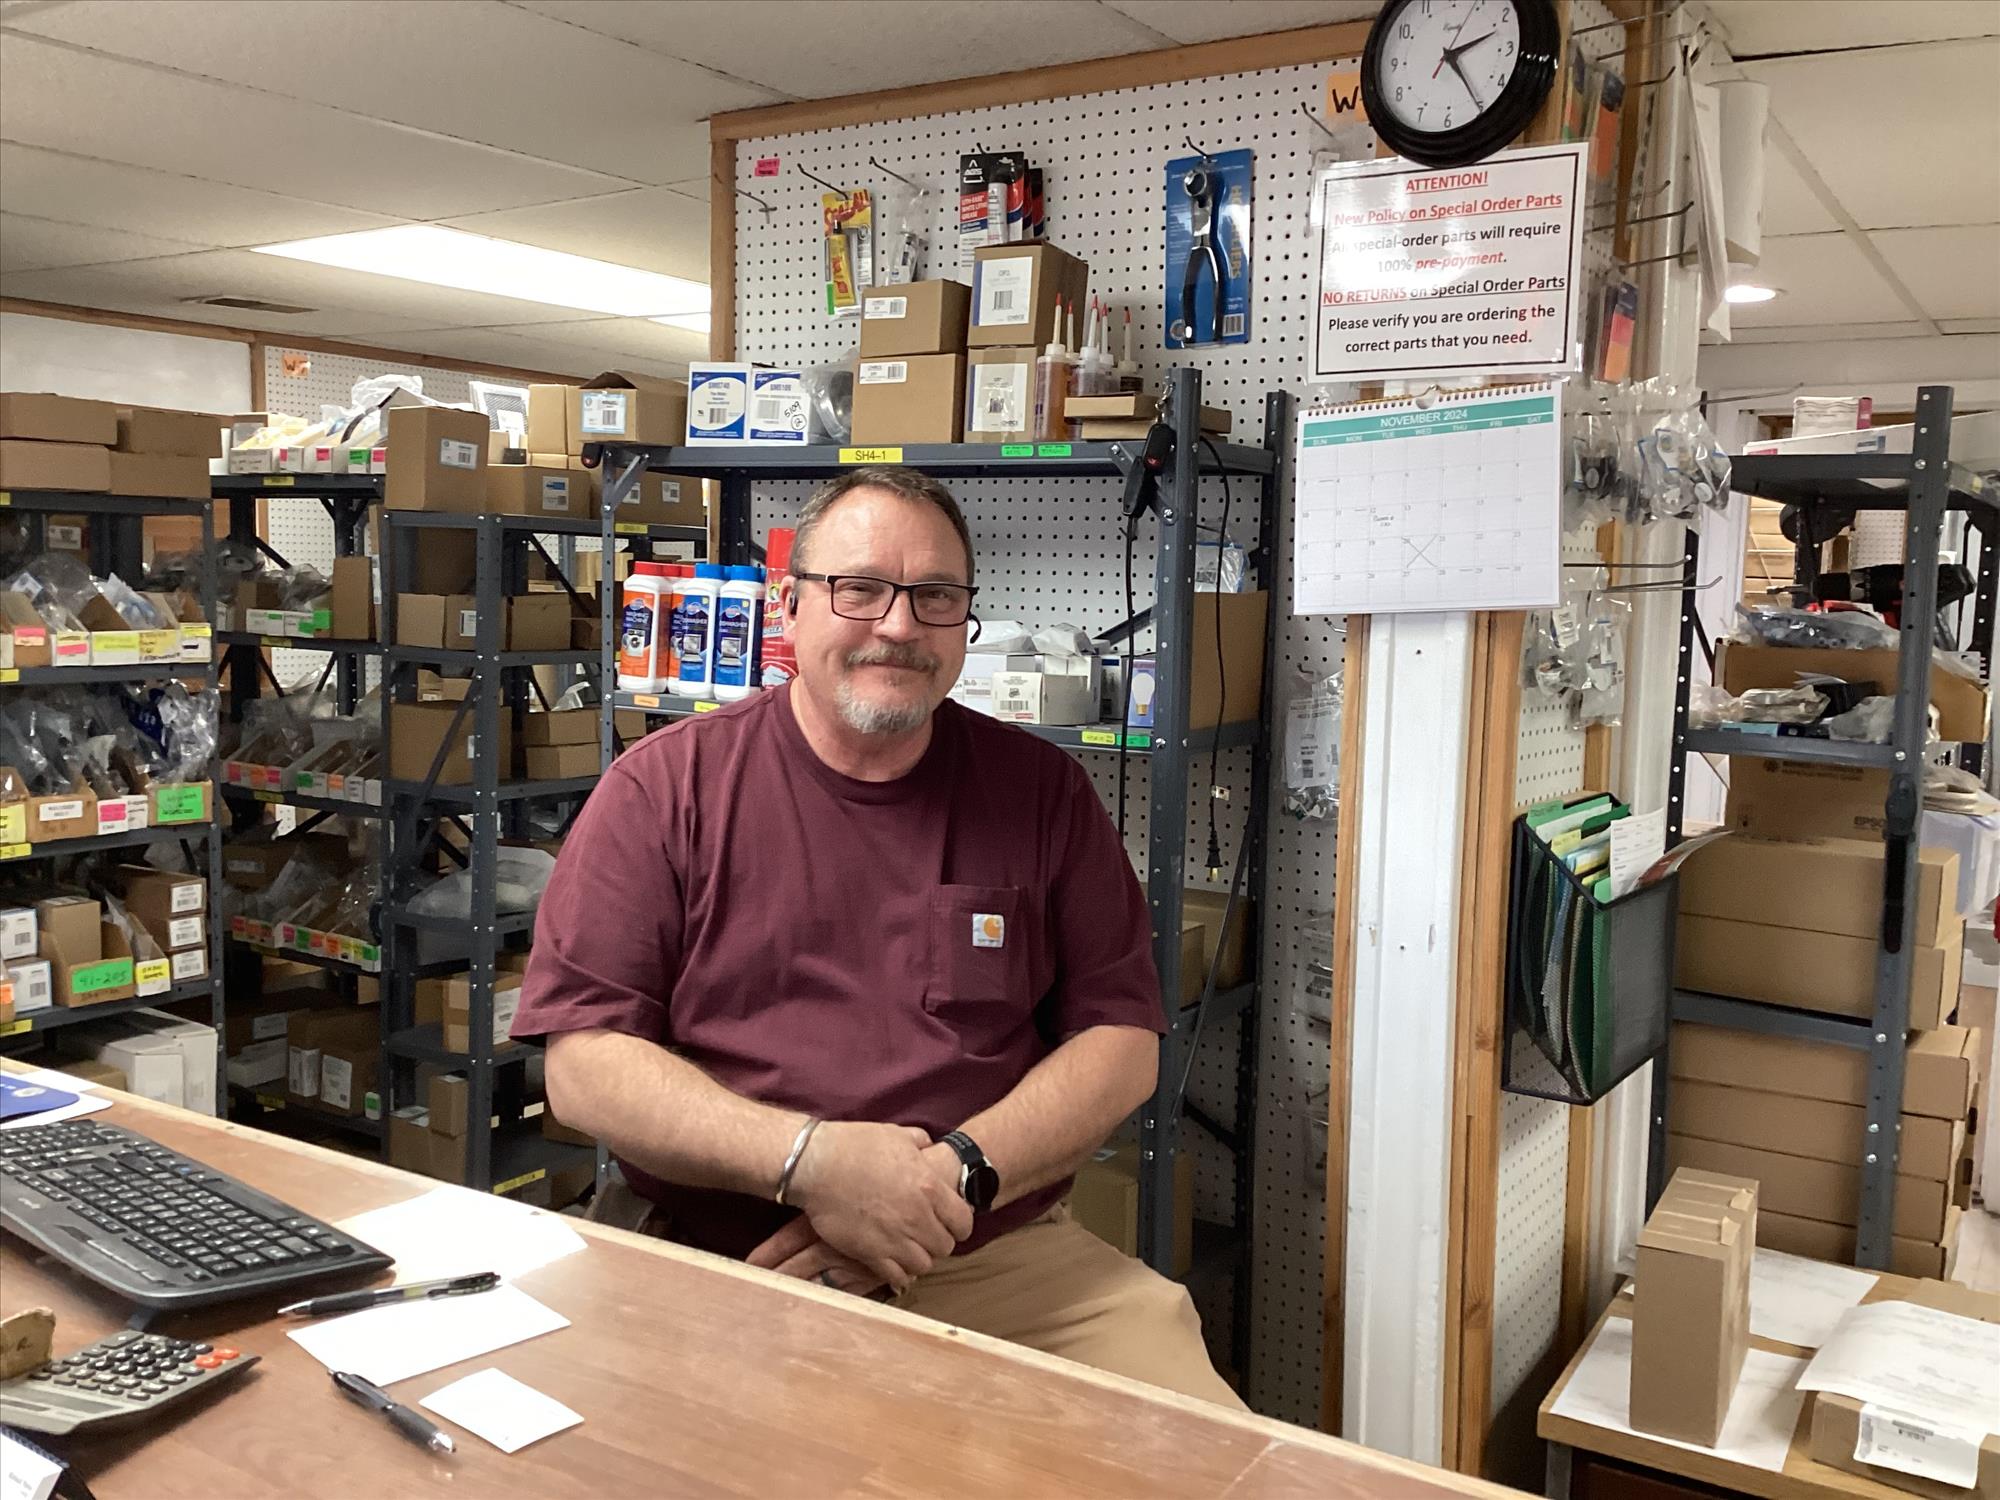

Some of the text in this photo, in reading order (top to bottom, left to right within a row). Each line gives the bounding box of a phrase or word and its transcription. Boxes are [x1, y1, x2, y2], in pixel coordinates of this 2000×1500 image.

[1502, 8, 1509, 23] 2
[1399, 24, 1411, 40] 10
[1505, 41, 1514, 57] 3
[1391, 58, 1398, 72] 9
[1497, 73, 1505, 88] 4
[1396, 86, 1403, 102] 8
[1417, 107, 1424, 122] 7
[1444, 113, 1451, 128] 6
[1406, 171, 1488, 192] ATTENTION!
[1334, 193, 1562, 226] New Policy on Special Order Parts
[1441, 231, 1475, 247] parts
[1480, 226, 1504, 240] will
[1508, 222, 1561, 240] require
[1379, 252, 1507, 273] 100% pre-payment.
[1323, 276, 1565, 304] NO RETURNS on Special Order Parts
[1328, 304, 1555, 331] Please verify you are ordering the
[1345, 330, 1532, 353] correct parts that you need.
[1380, 409, 1468, 428] NOVEMBER 2024
[1527, 416, 1542, 424] SAT
[855, 450, 886, 461] SH4-1
